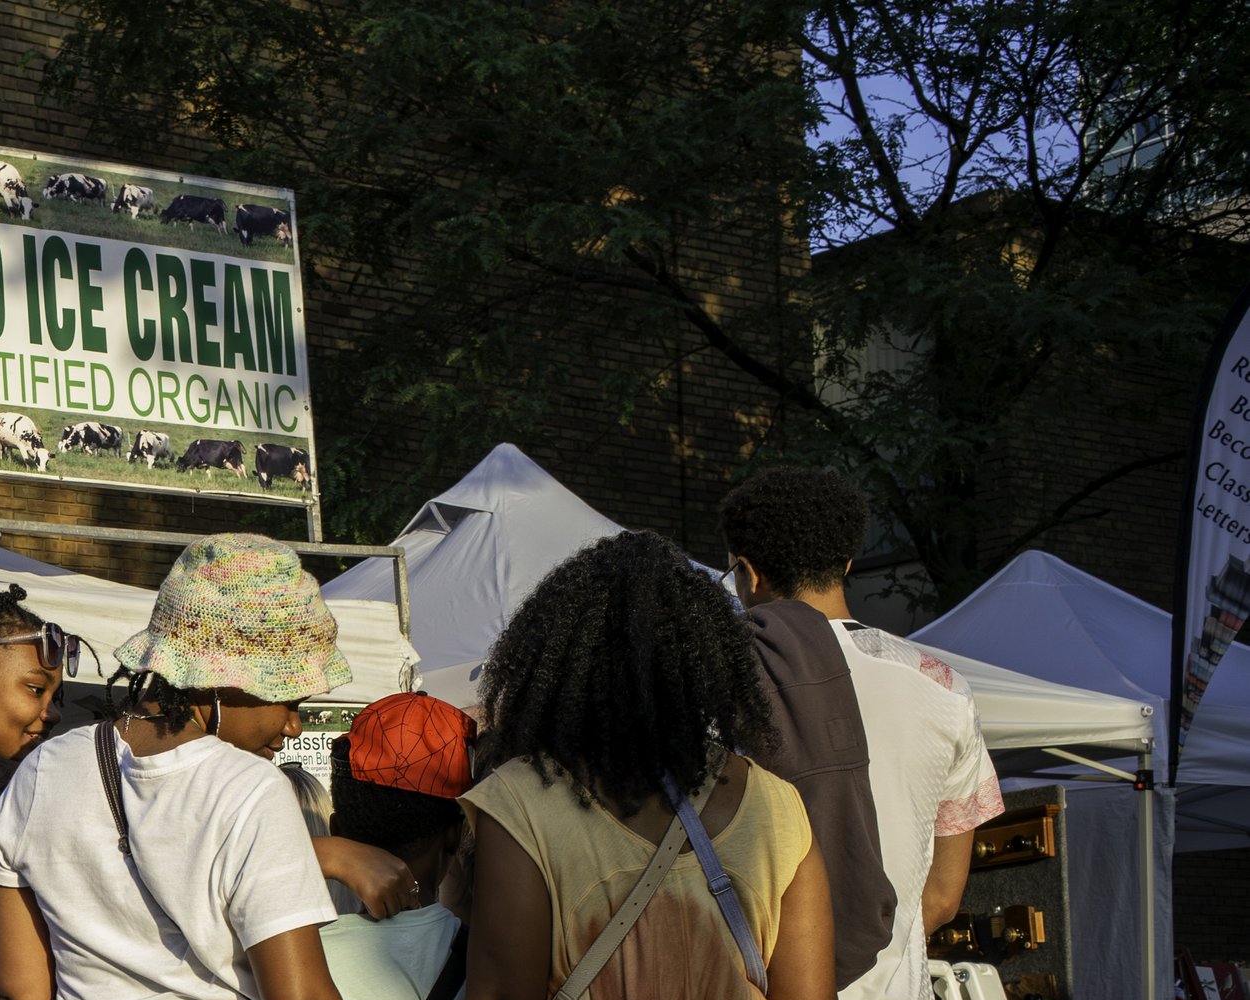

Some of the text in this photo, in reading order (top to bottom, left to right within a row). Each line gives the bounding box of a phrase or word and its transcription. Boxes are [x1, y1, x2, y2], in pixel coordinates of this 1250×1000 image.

[24, 234, 108, 354] ICE
[124, 247, 297, 377] CREAM
[127, 368, 299, 433] ORGANIC
[279, 751, 314, 765] Reuben
[281, 732, 333, 750] rassfe
